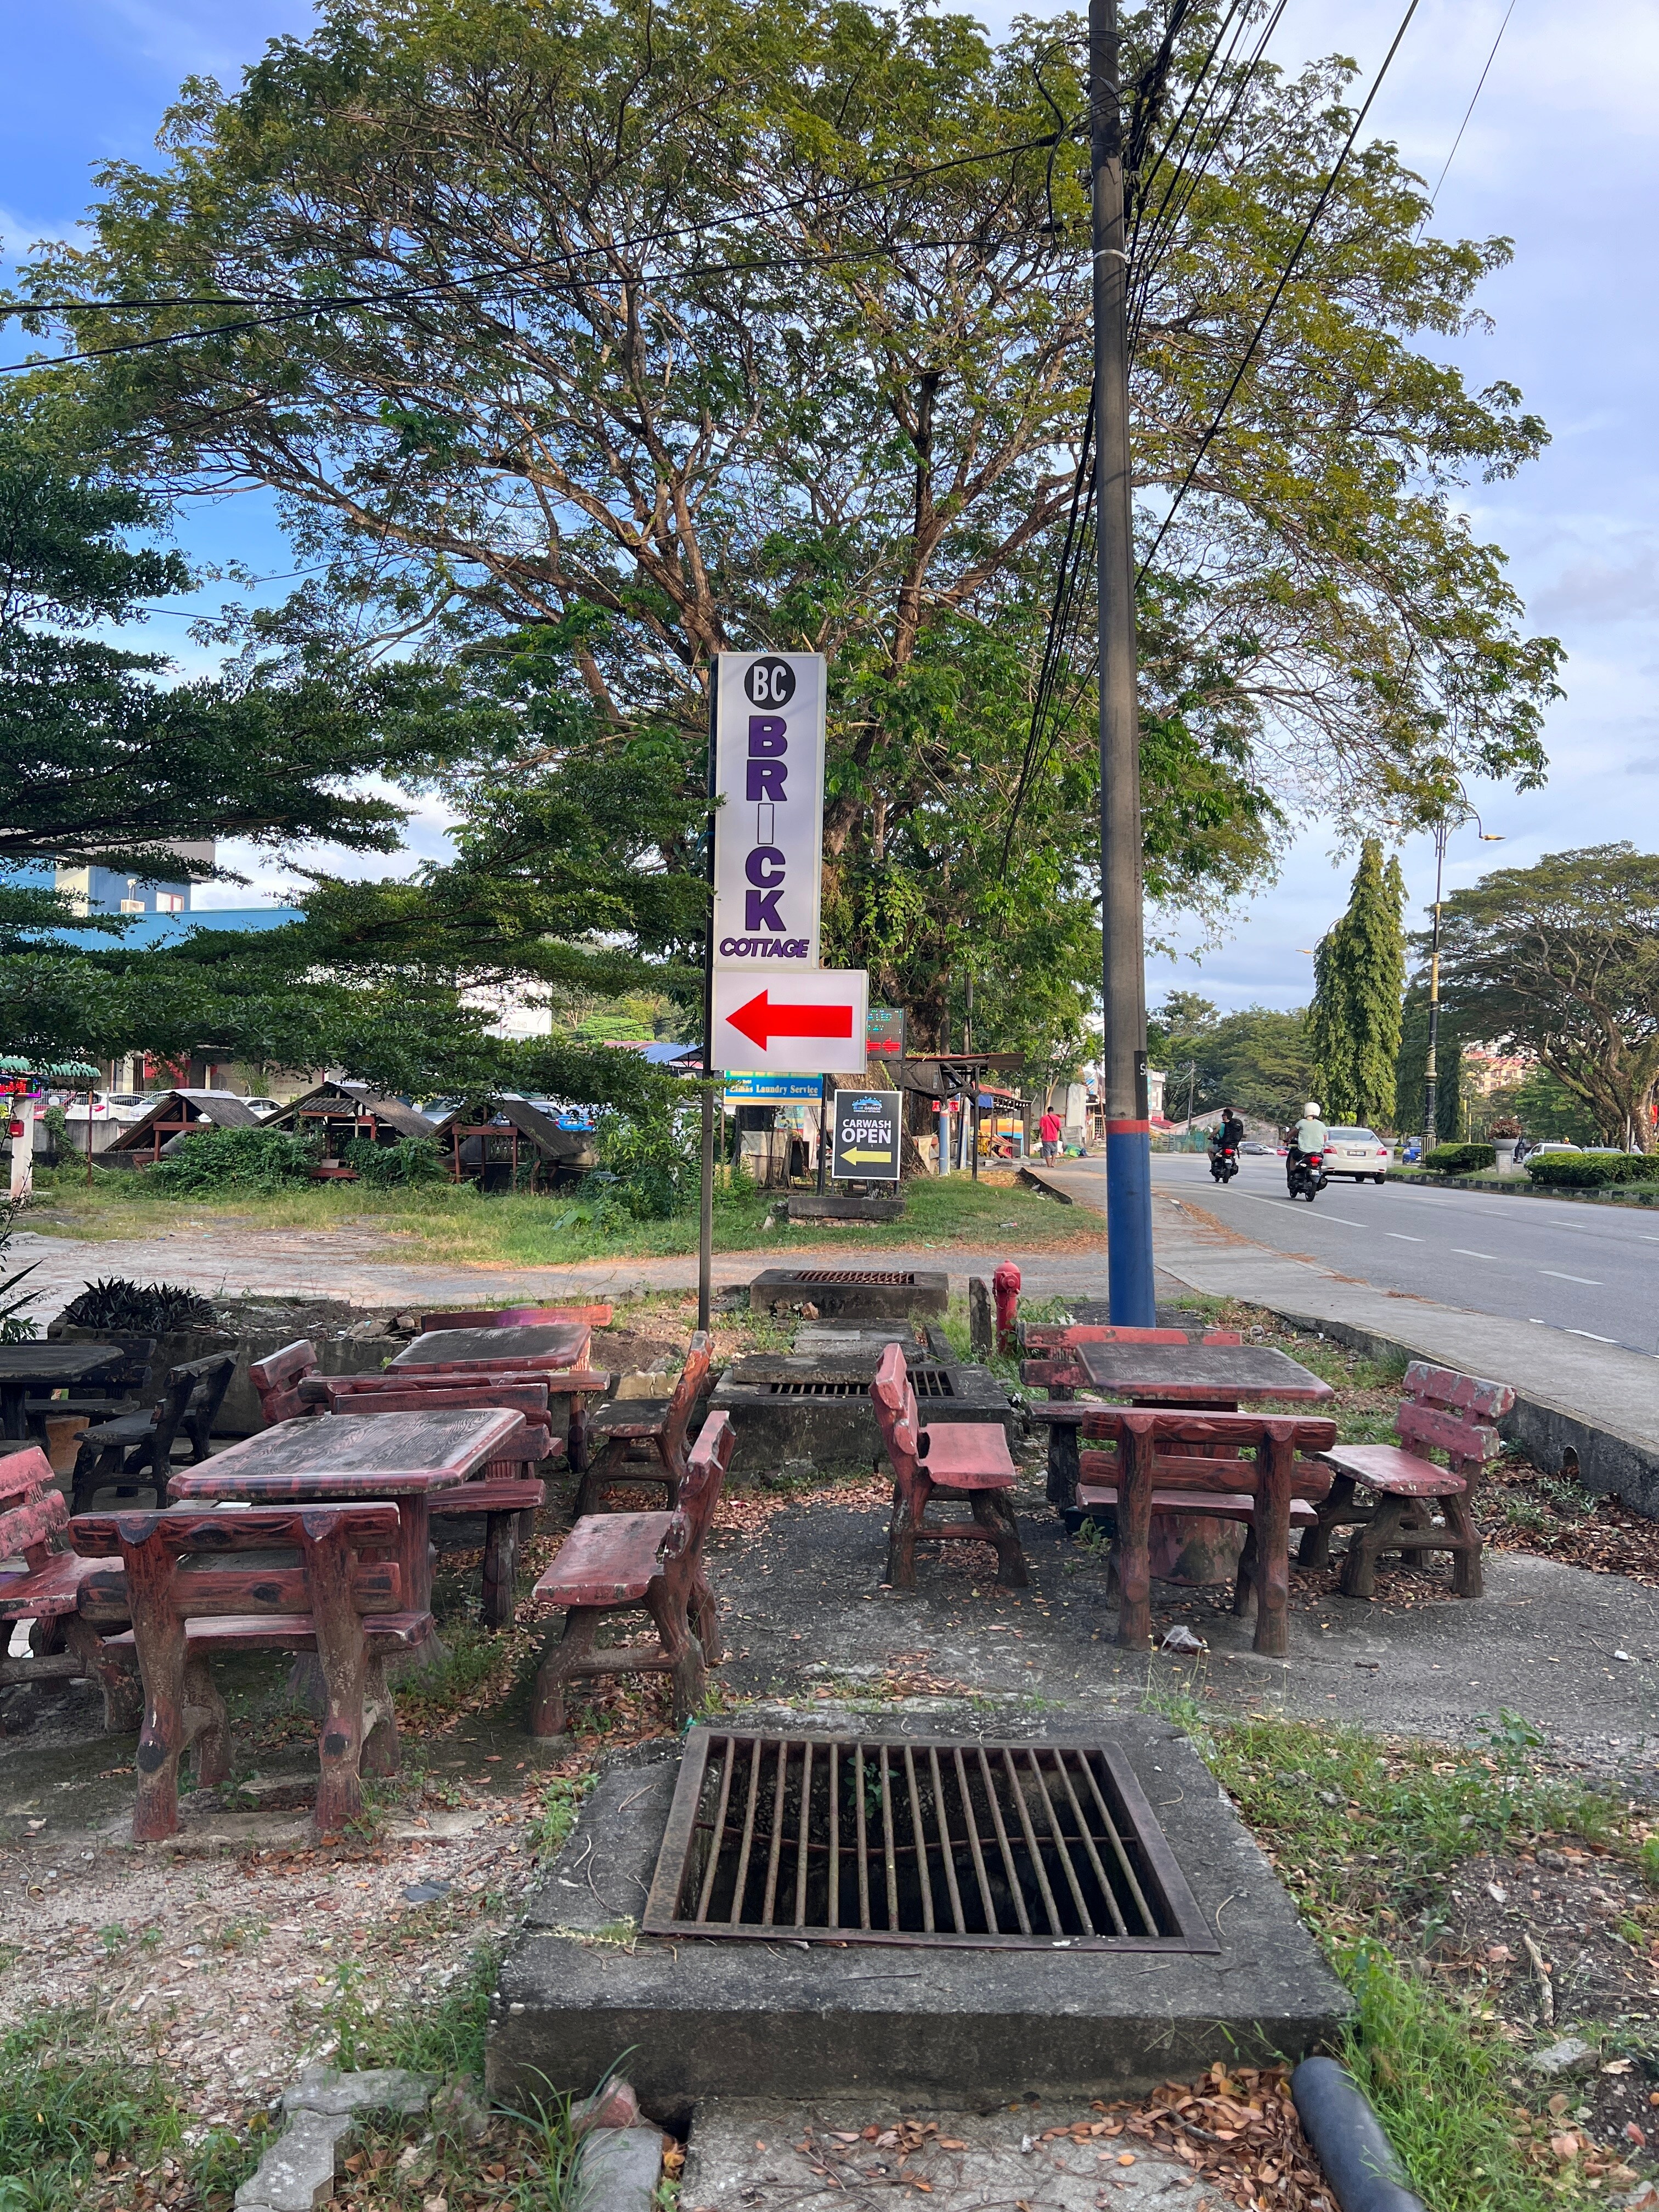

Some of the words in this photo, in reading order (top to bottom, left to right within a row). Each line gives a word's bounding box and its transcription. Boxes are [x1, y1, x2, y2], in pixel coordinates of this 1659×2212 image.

[753, 665, 787, 702] BC
[745, 715, 788, 932] BRICK
[719, 937, 810, 958] COTTAGE
[756, 1085, 787, 1095] Laundry
[790, 1085, 818, 1094] Service
[842, 1119, 891, 1129] CARWASH
[842, 1127, 891, 1144] OPEN
